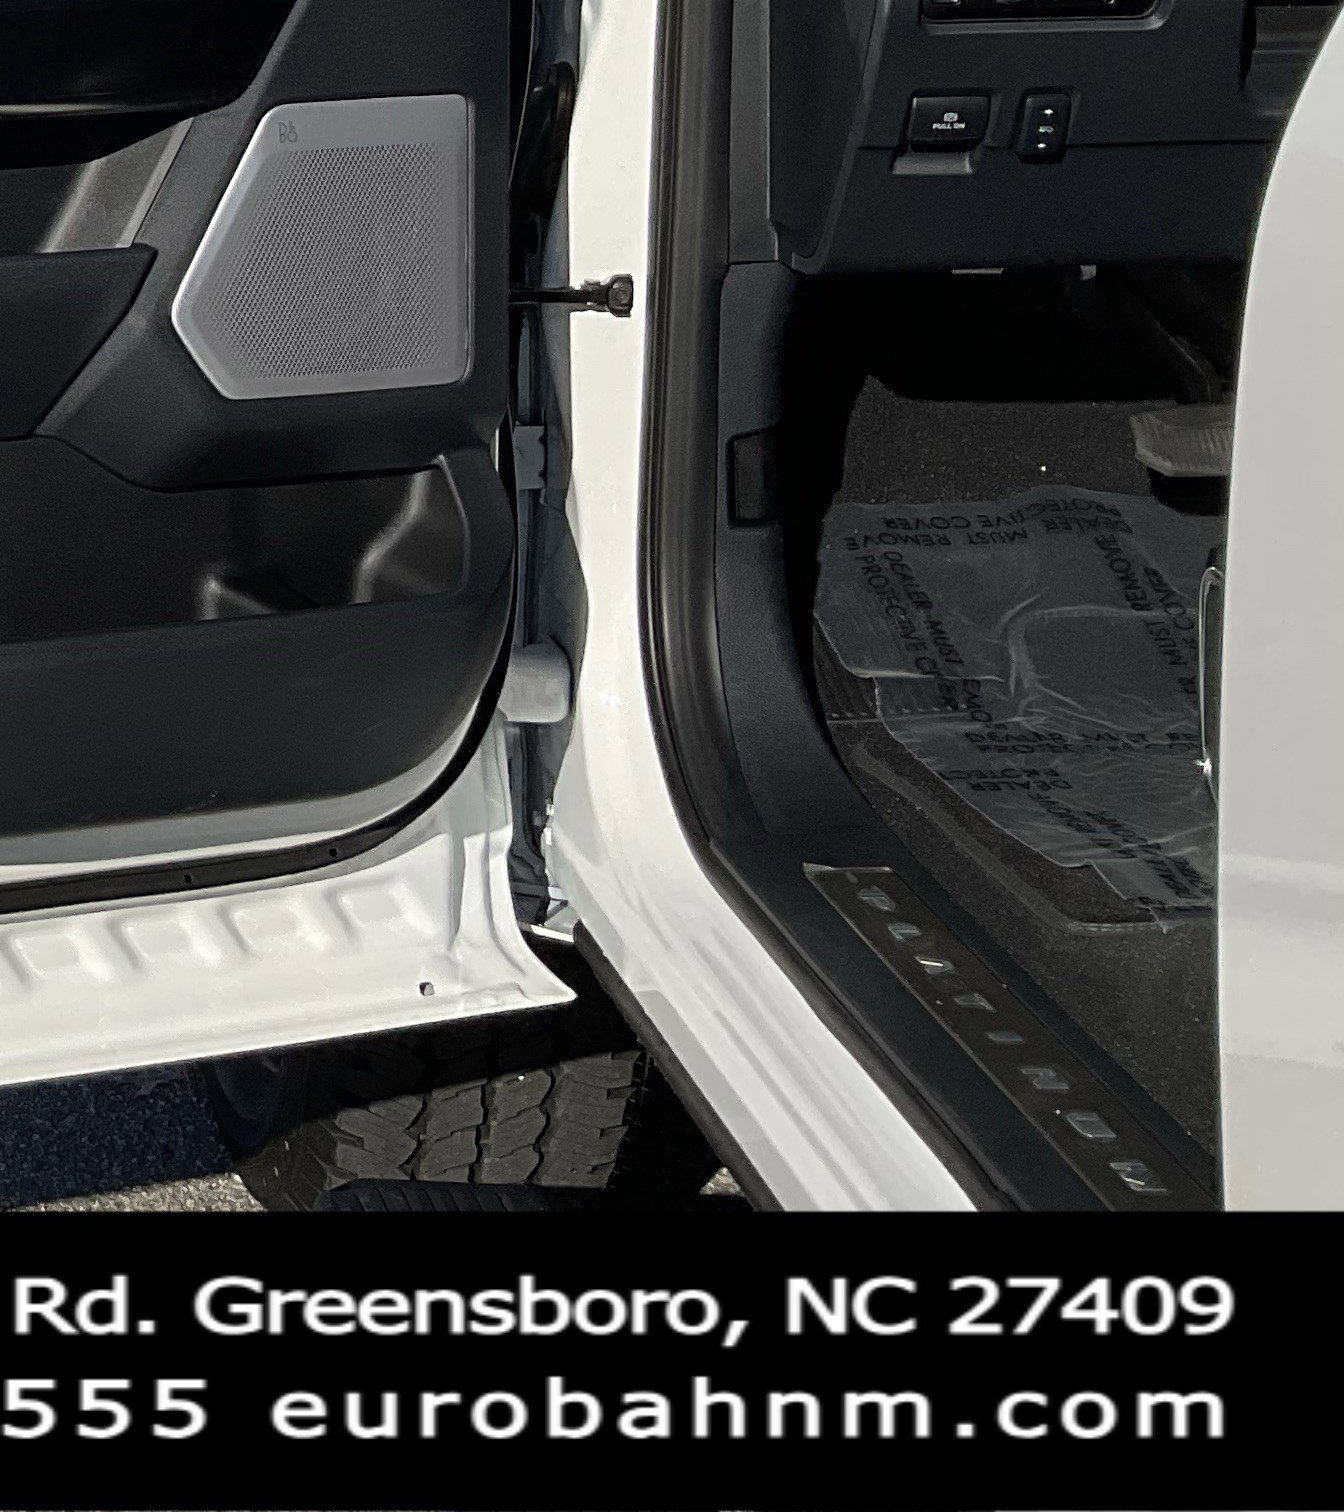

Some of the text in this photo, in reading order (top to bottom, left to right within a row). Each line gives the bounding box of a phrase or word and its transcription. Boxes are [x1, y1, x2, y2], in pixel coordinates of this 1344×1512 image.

[884, 514, 971, 531] COVER
[845, 533, 953, 551] REMOVE
[966, 527, 1028, 545] MUST
[924, 618, 964, 667] MUST
[858, 884, 1169, 1193] PLATINUM
